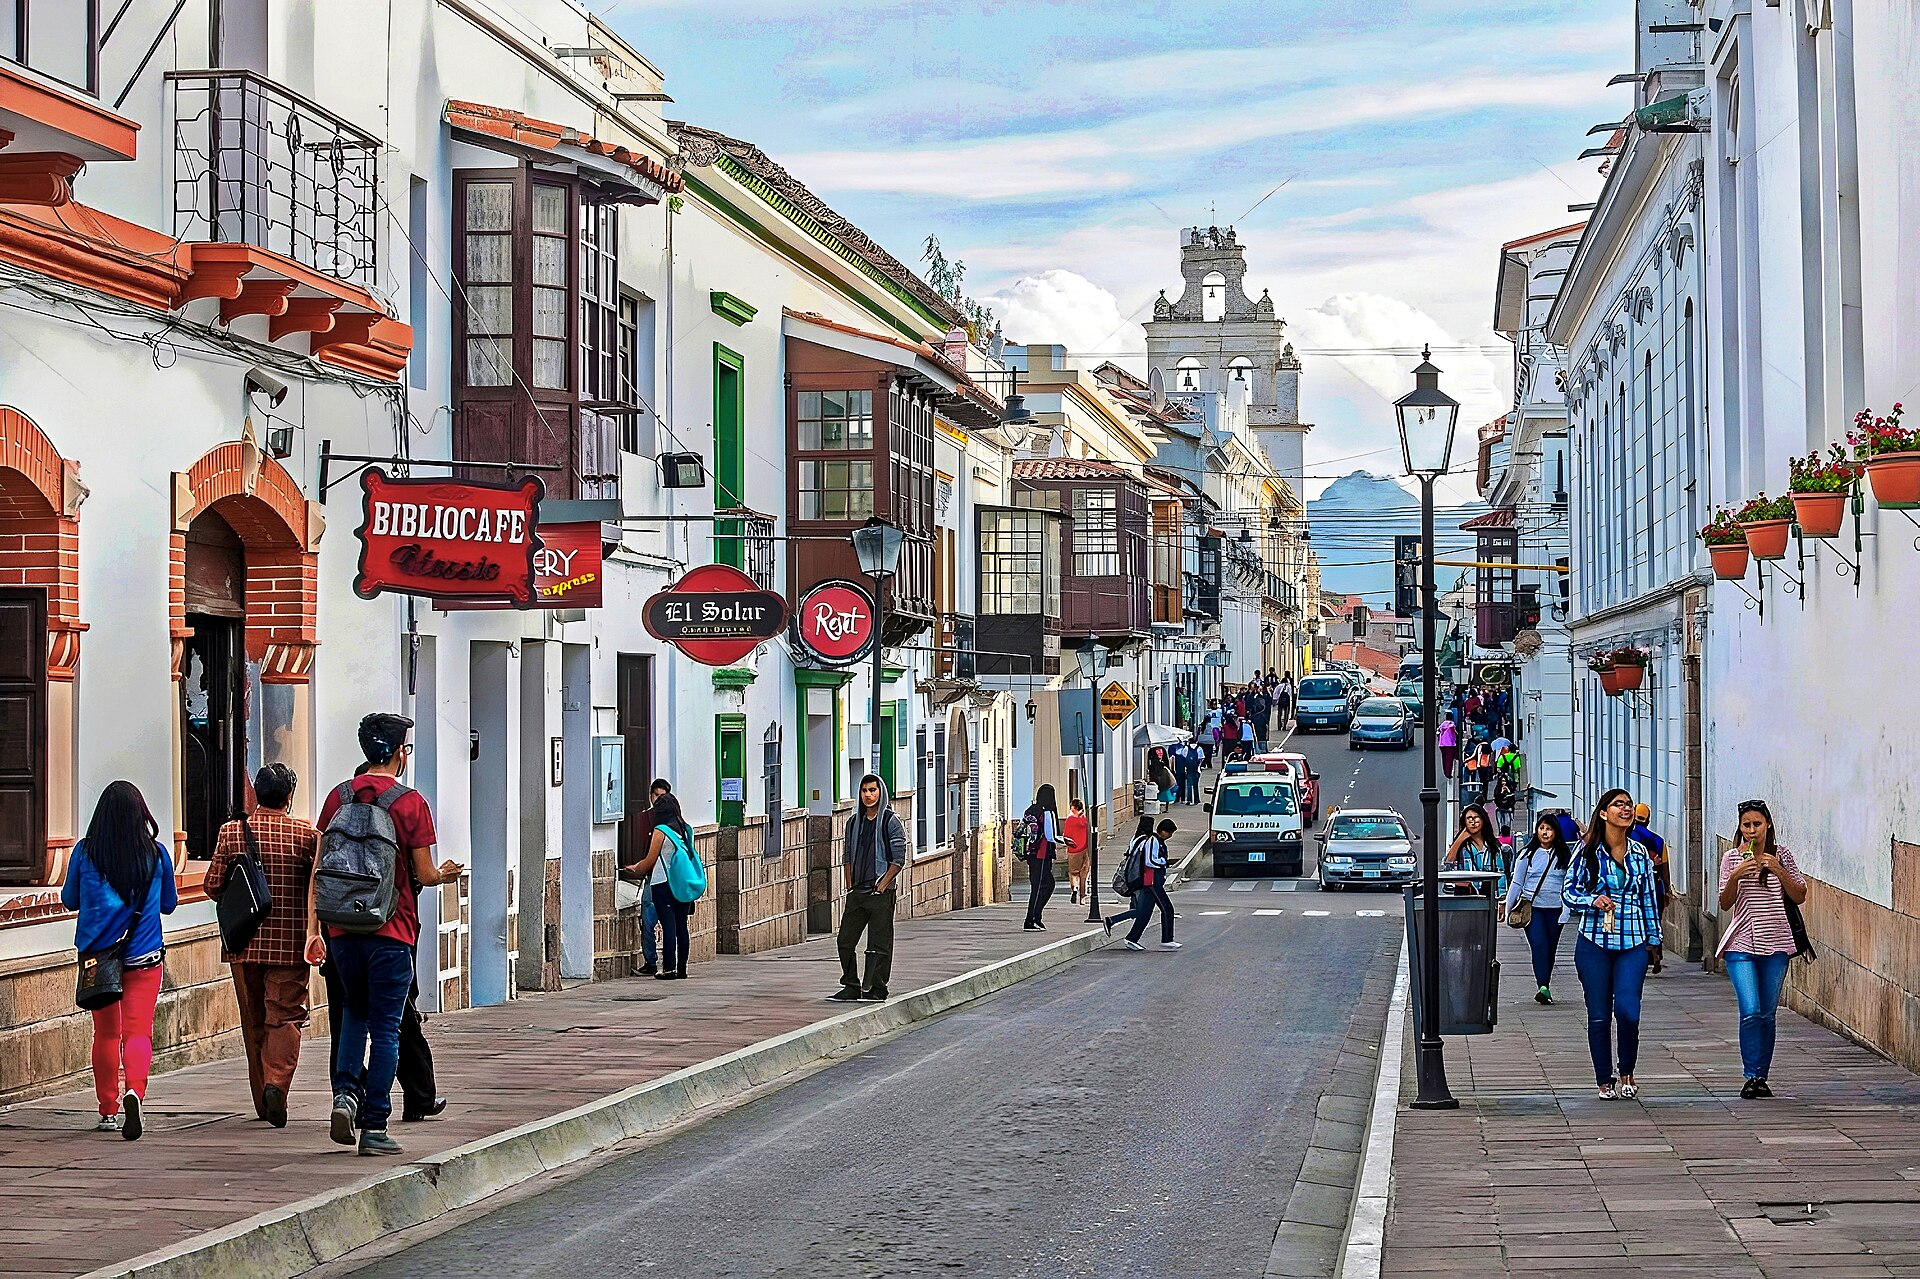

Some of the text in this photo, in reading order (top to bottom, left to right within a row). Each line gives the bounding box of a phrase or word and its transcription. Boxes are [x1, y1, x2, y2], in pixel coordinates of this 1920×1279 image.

[372, 501, 526, 544] BIBLIOCAFE
[664, 601, 766, 622] El Solar
